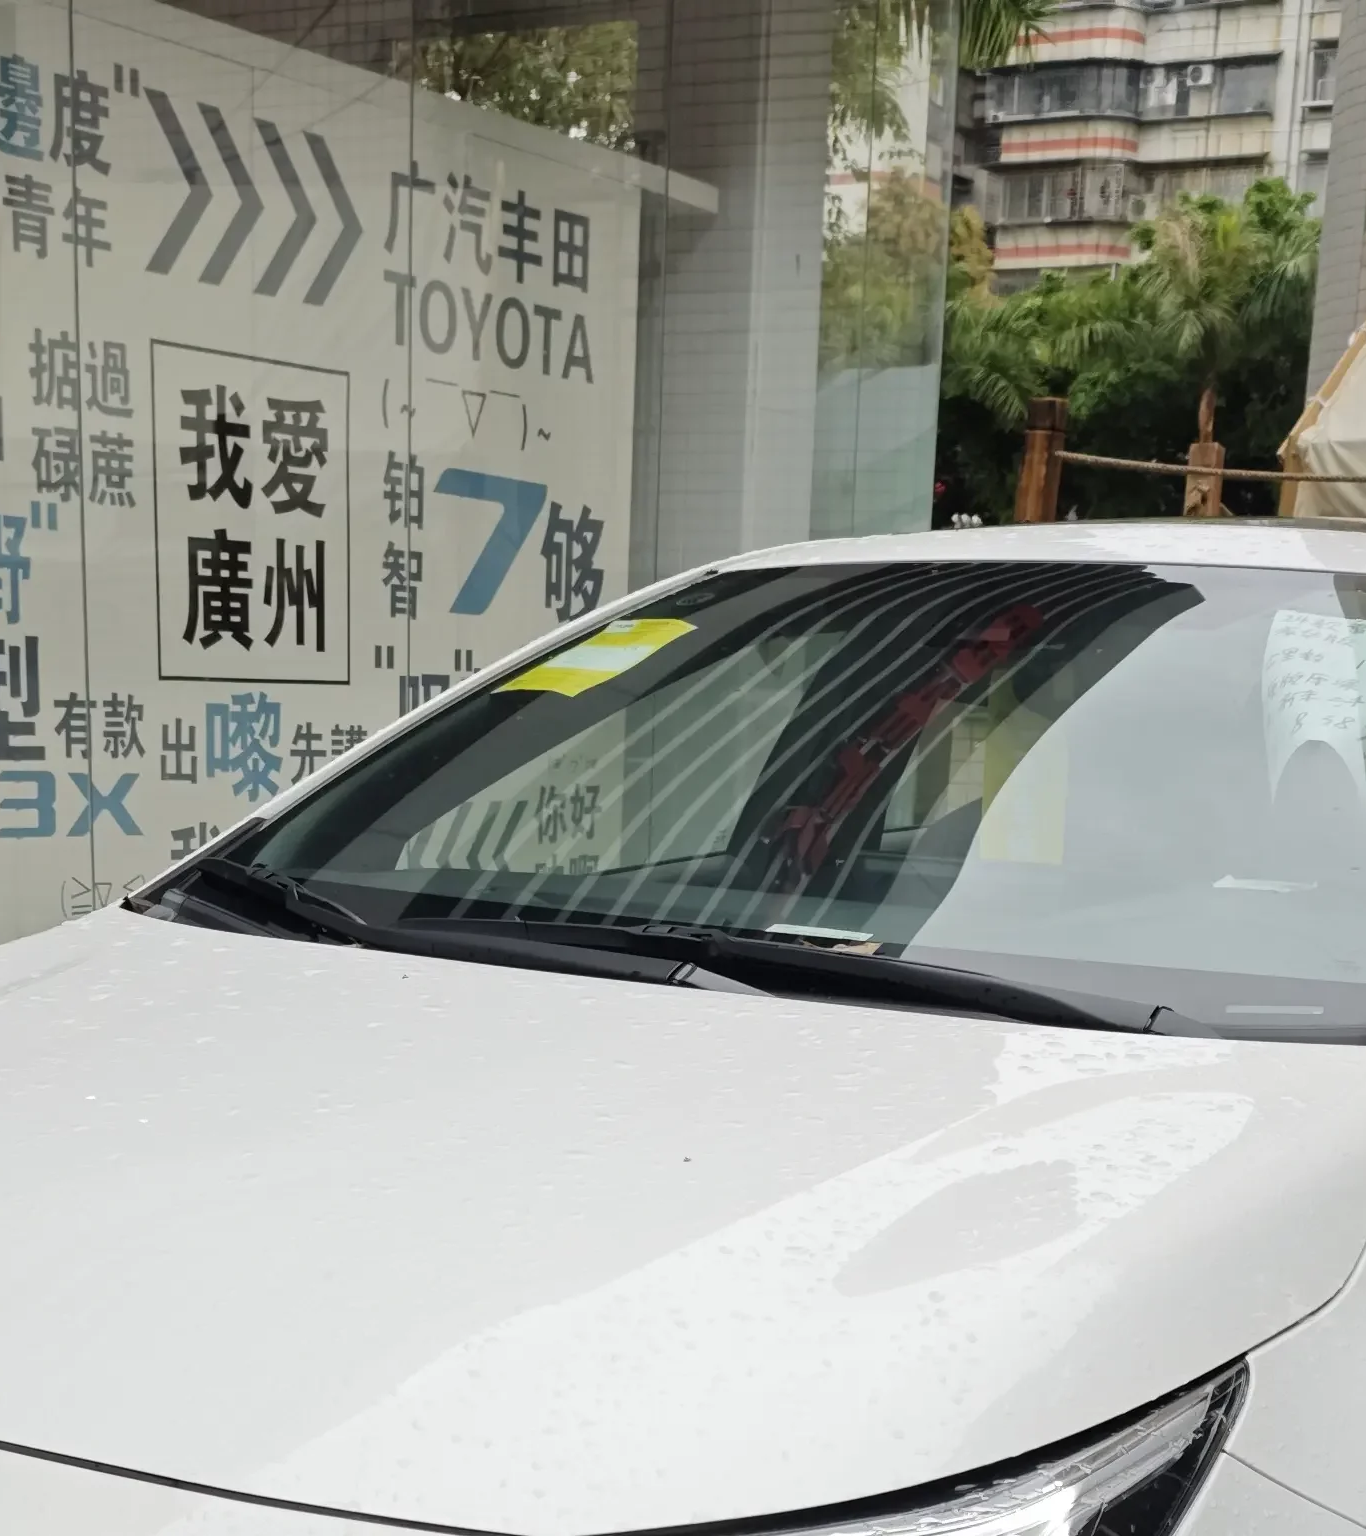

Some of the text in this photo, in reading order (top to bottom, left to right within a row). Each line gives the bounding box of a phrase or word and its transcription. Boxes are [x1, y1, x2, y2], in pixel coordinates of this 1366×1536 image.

[383, 160, 590, 293] 广汽丰田
[28, 328, 135, 420] 掂過
[382, 269, 594, 384] TOYOTA
[180, 384, 329, 518] 我愛
[182, 529, 326, 652] 廣州
[433, 467, 548, 615] 7
[540, 501, 606, 623] 够
[54, 691, 146, 760] 有款
[534, 784, 602, 845] 你好
